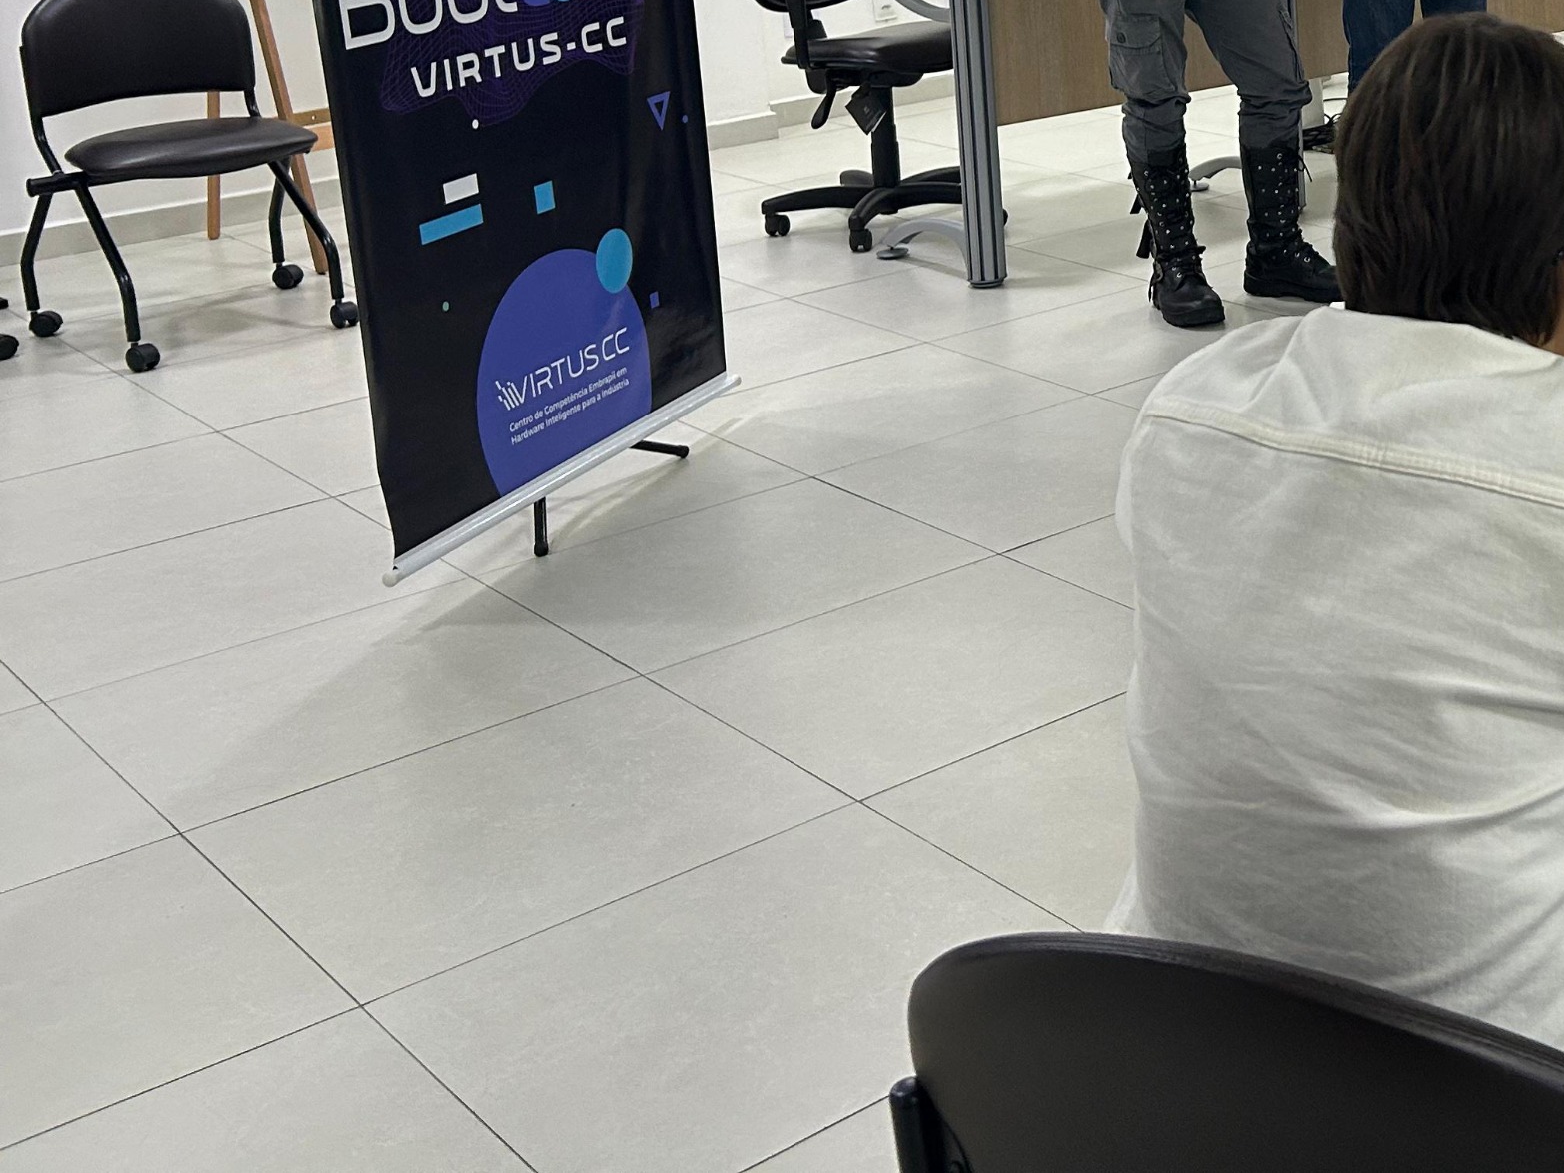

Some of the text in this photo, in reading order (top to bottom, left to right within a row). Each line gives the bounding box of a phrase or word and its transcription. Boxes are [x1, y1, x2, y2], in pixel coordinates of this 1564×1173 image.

[410, 16, 627, 98] VIRTUS-CC
[509, 414, 533, 432] Centro
[534, 408, 543, 420] de
[543, 387, 588, 416] Competência
[616, 366, 628, 378] em
[510, 421, 545, 445] Hardware
[545, 405, 582, 427] Inteligente
[582, 397, 597, 412] para
[601, 378, 630, 399] Indústria
